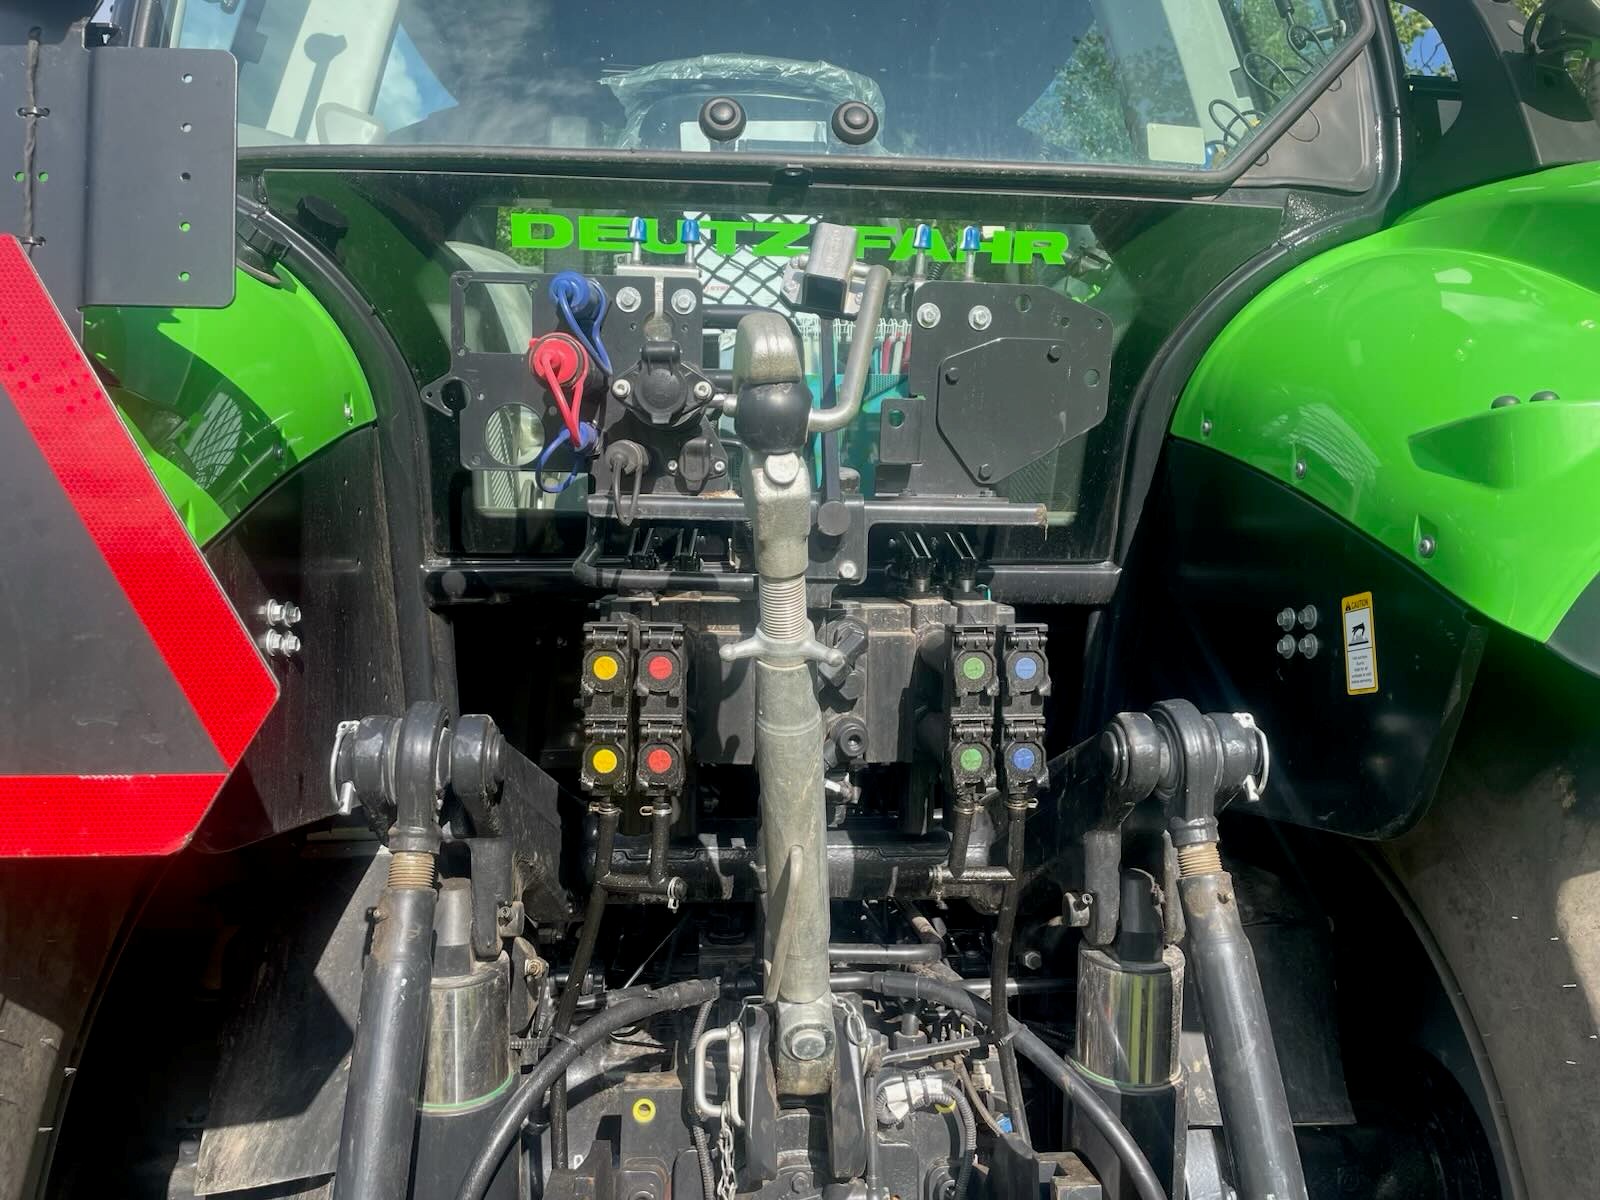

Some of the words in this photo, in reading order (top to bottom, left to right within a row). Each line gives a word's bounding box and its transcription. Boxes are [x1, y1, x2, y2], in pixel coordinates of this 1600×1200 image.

[511, 213, 810, 257] DEUTZ
[854, 225, 1069, 265] FAHR
[1351, 598, 1369, 610] CAUTION
